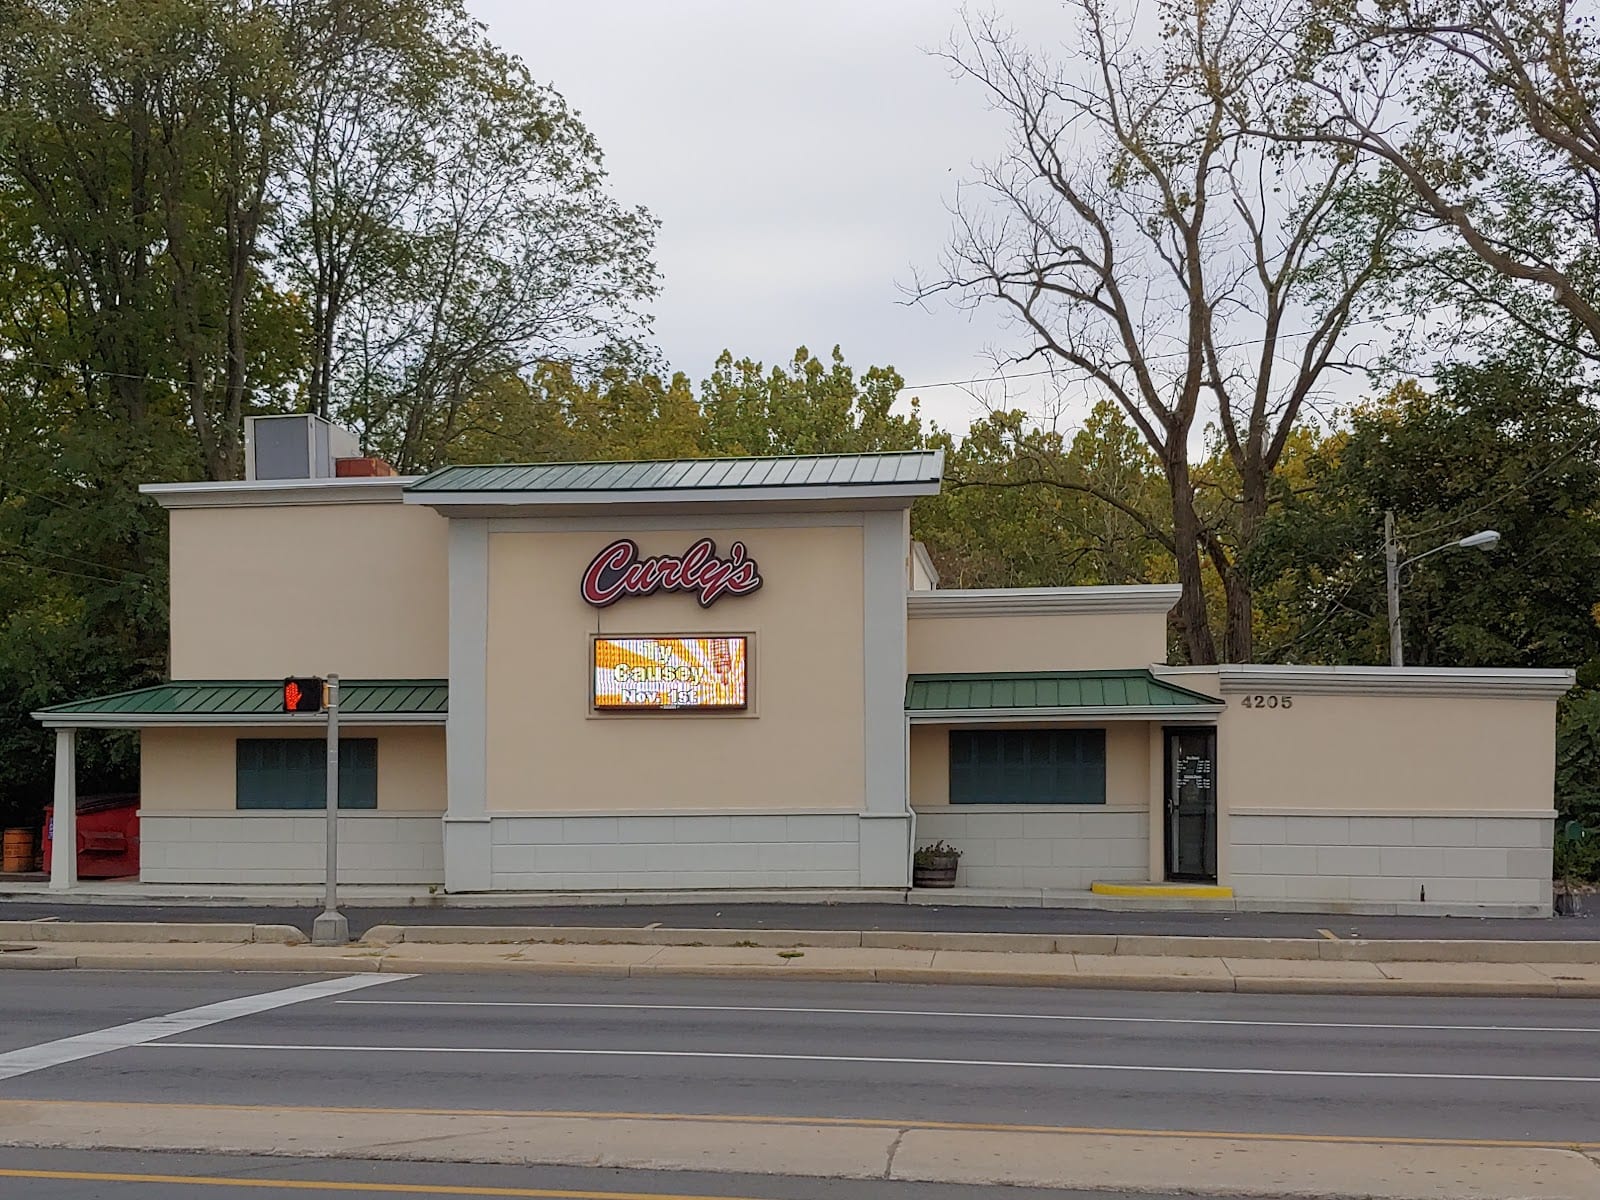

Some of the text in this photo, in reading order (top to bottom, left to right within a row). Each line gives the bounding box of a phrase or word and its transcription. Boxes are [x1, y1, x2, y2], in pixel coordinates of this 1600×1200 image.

[582, 540, 760, 606] Curly's
[643, 640, 673, 664] Ty
[614, 663, 704, 686] Causey
[622, 689, 699, 704] Nov. 1st
[1241, 695, 1293, 709] 4205
